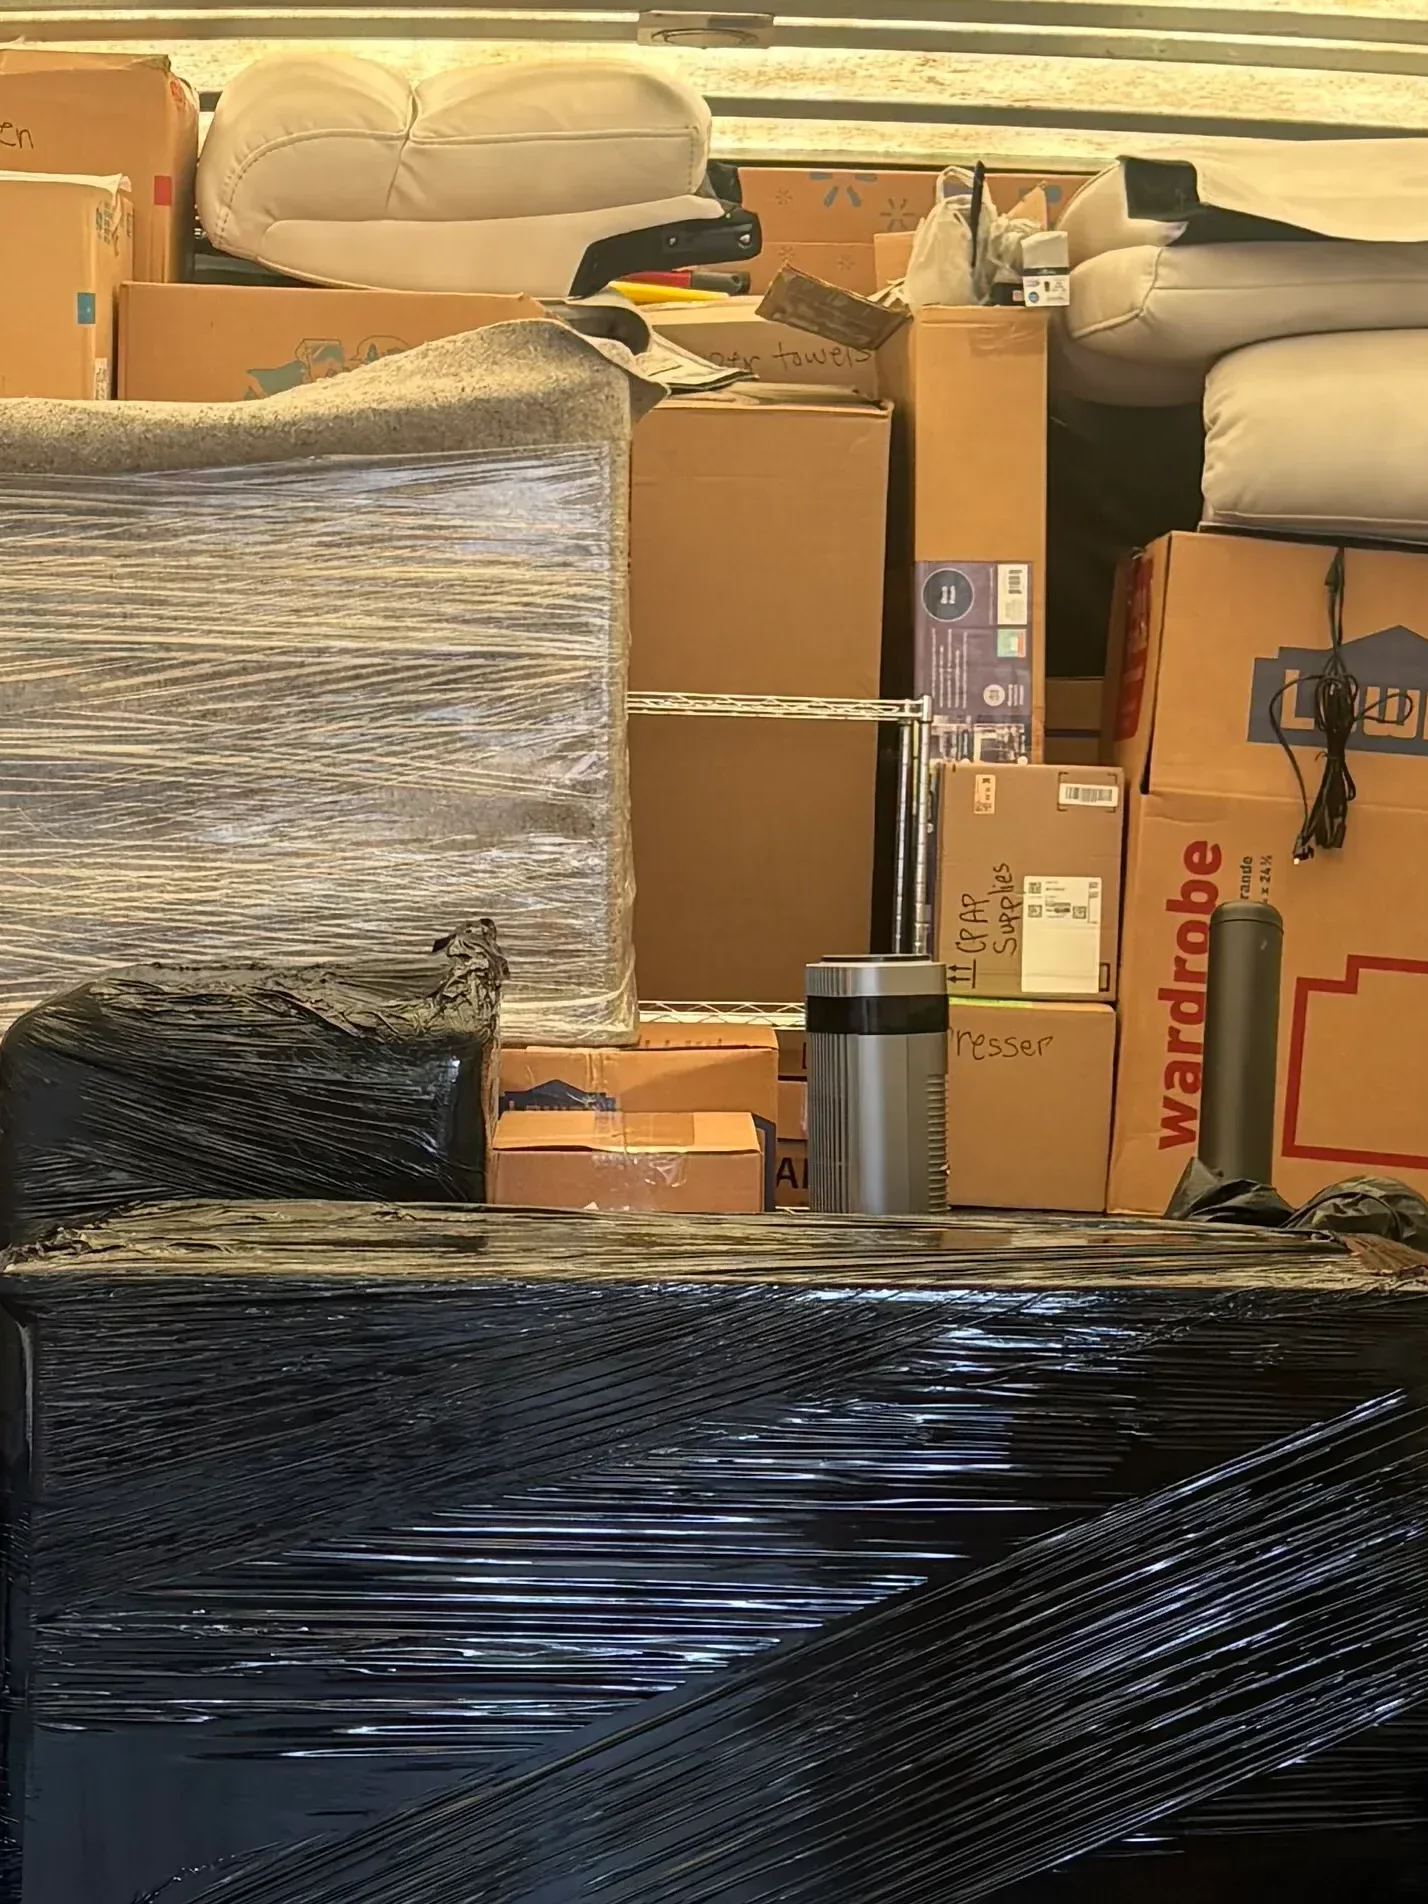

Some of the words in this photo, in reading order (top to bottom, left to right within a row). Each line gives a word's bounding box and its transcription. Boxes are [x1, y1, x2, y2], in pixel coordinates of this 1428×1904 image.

[772, 342, 871, 370] towels
[1240, 856, 1253, 900] rande
[987, 862, 1023, 957] Supplies
[1158, 840, 1222, 1151] wardrobe
[947, 1026, 1054, 1061] resser
